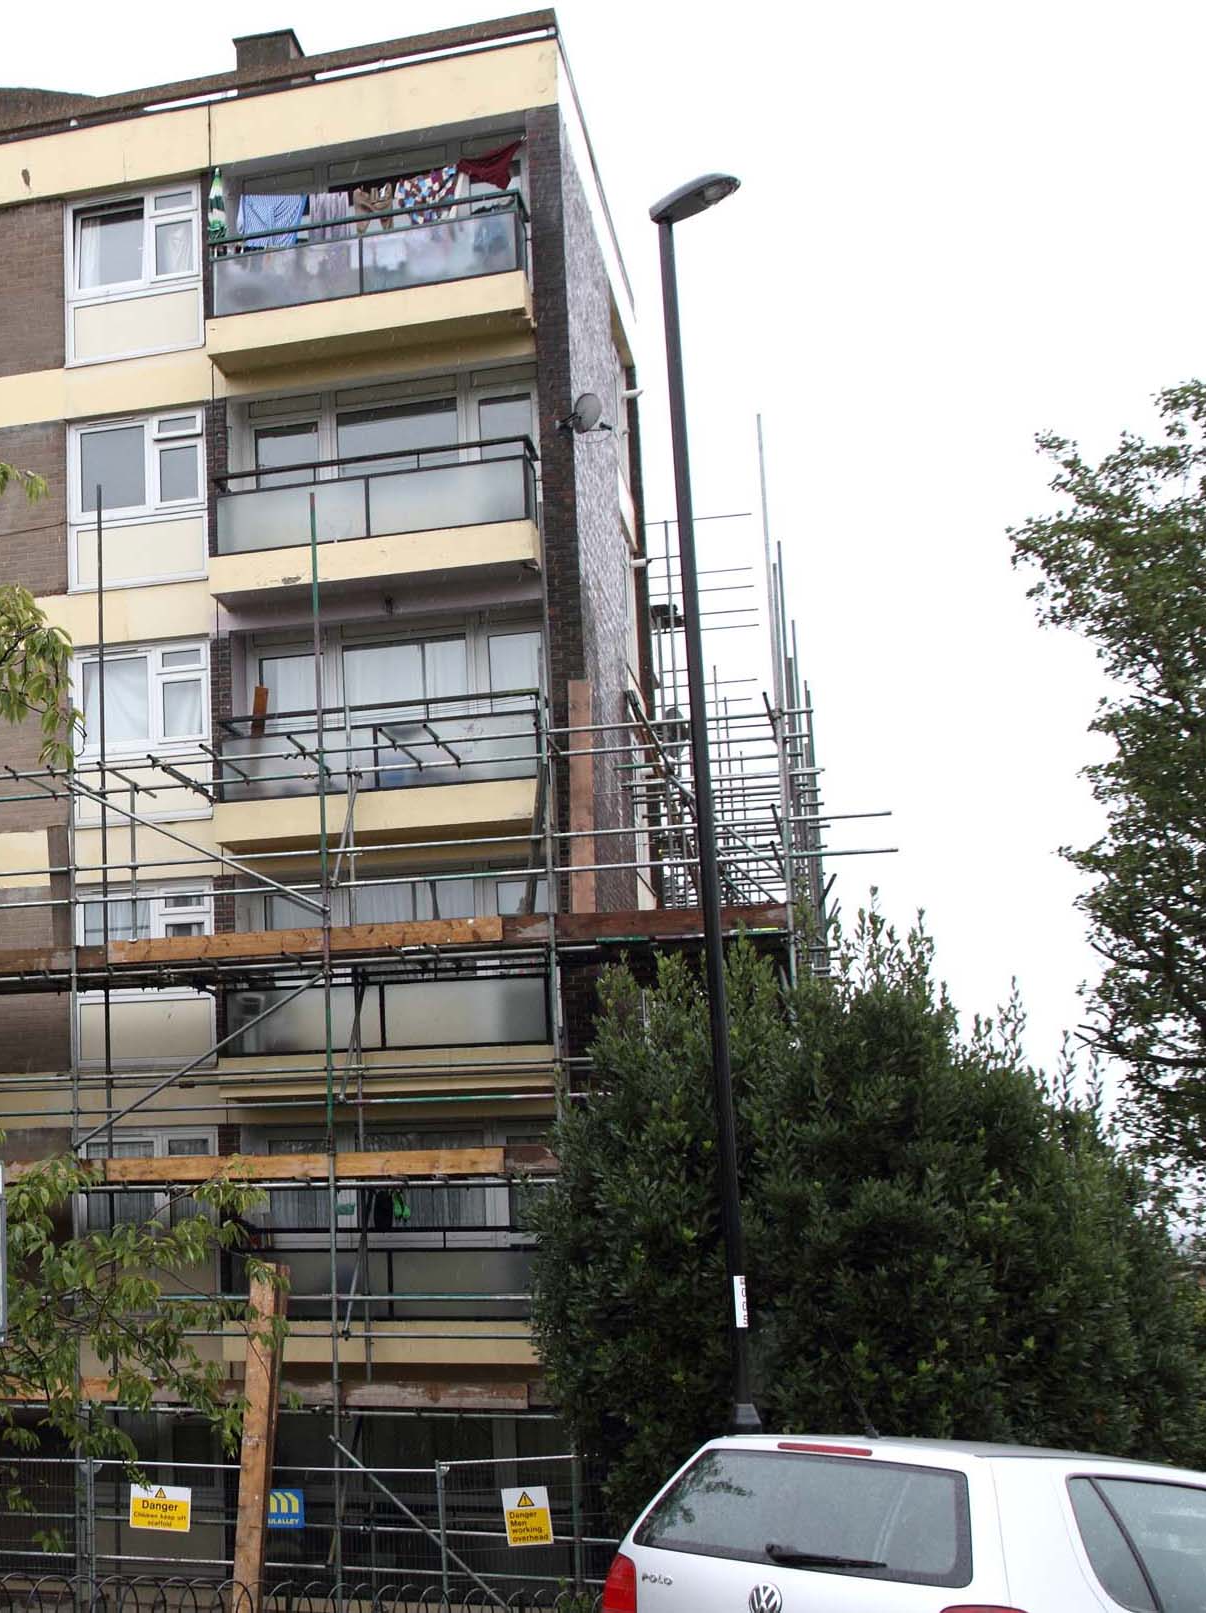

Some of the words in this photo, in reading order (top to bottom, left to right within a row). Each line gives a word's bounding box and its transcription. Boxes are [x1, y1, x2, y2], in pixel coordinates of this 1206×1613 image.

[141, 1499, 178, 1512] Danger
[509, 1511, 537, 1519] Danger
[512, 1526, 543, 1534] working
[512, 1534, 549, 1542] overhead
[642, 1572, 673, 1586] POLO
